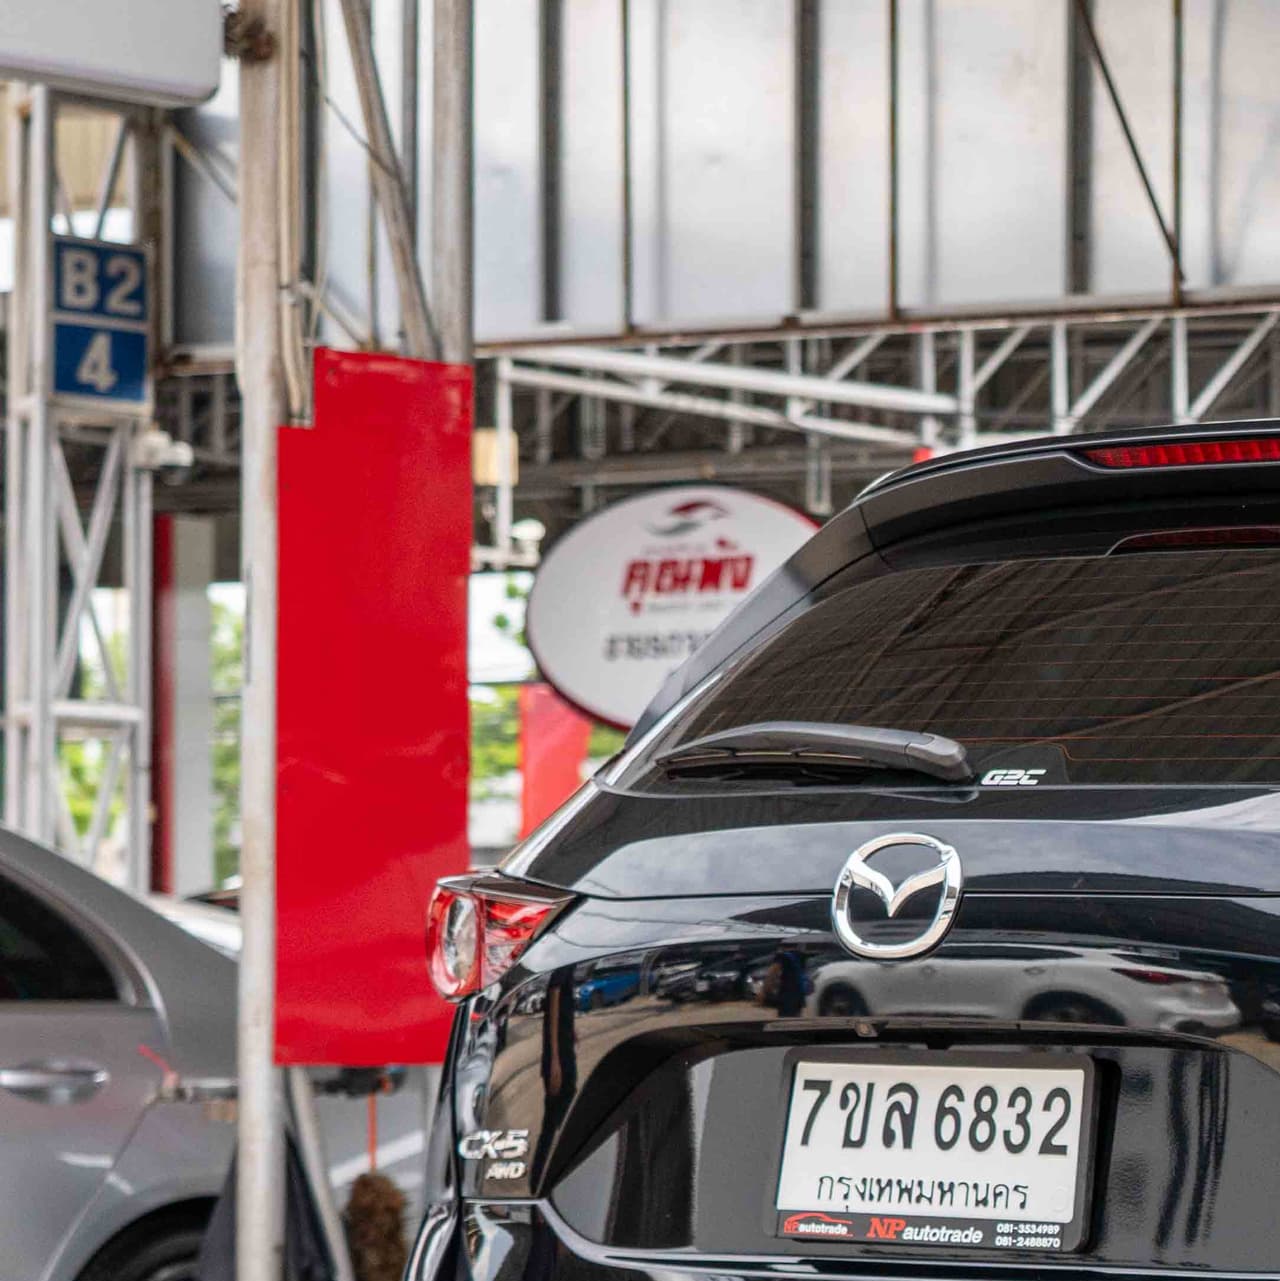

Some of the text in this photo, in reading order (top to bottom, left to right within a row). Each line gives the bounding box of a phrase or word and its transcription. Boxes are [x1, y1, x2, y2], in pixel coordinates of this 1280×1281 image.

[61, 249, 141, 315] B2
[76, 331, 118, 392] 4
[933, 1083, 1072, 1156] 6832
[486, 1161, 527, 1180] AWD
[817, 1174, 1030, 1212] กรุงเทพมหานคร
